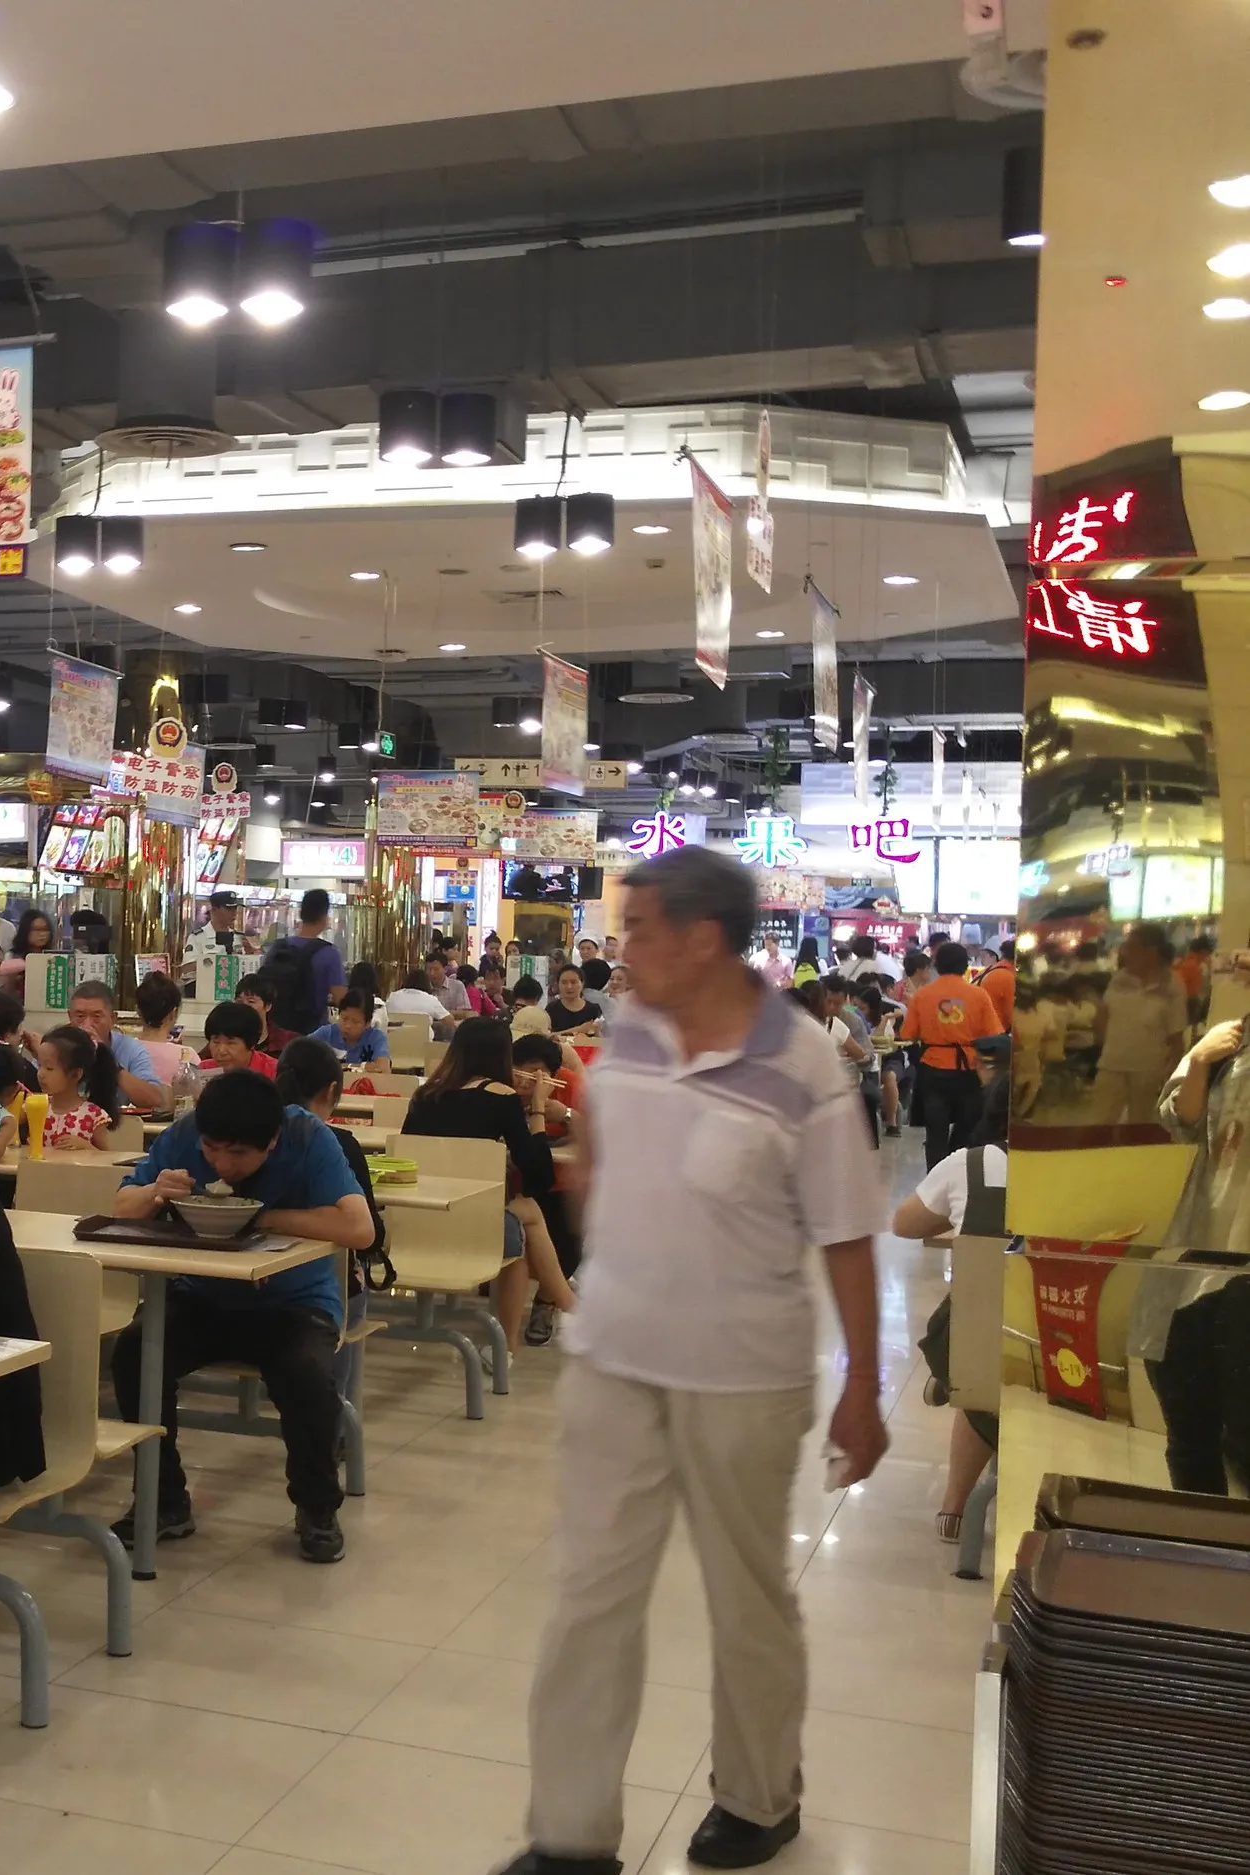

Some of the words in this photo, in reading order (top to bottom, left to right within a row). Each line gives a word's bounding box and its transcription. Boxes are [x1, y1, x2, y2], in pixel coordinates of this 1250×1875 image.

[127, 757, 200, 780] 电子警察
[123, 775, 198, 799] 防盗防窃
[201, 793, 249, 805] 电子警察
[625, 811, 923, 867] 水果吧
